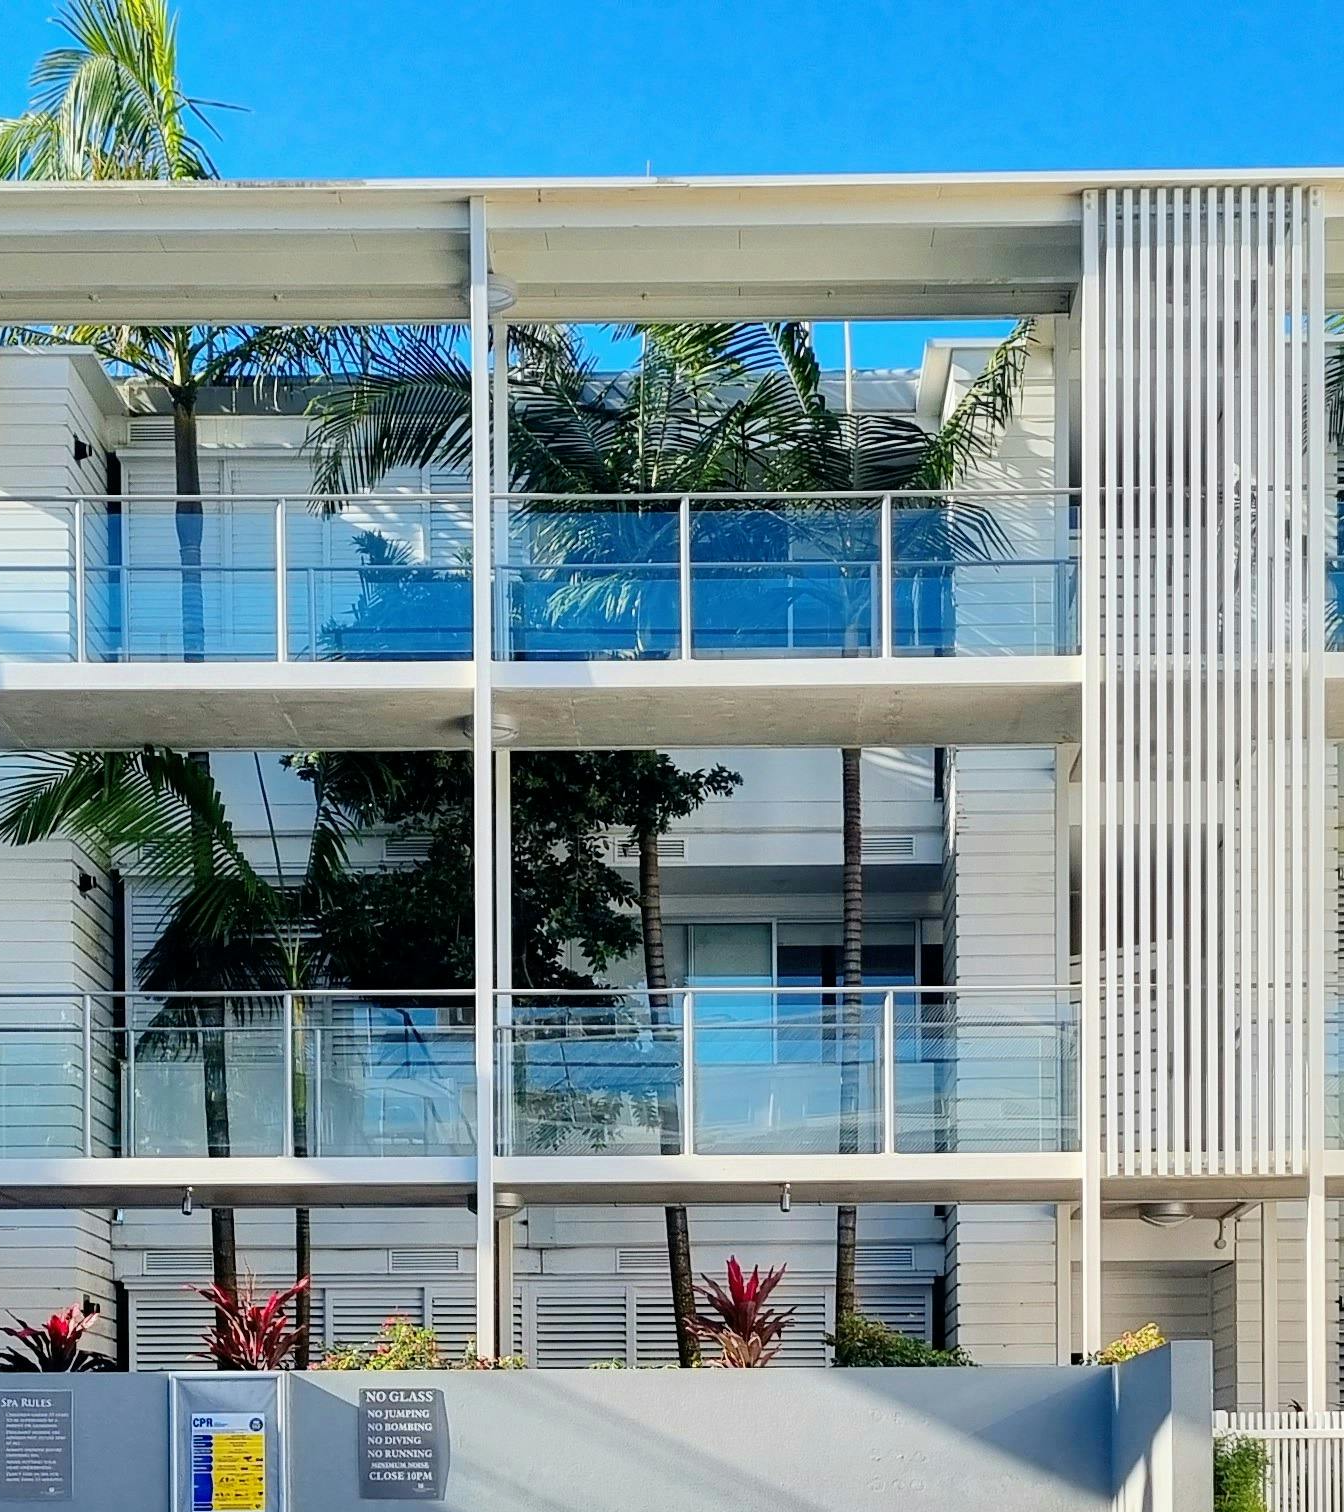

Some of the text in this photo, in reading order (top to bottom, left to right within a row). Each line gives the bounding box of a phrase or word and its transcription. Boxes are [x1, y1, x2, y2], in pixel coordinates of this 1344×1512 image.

[366, 1391, 433, 1402] NO GLASS
[368, 1410, 430, 1419] NO JUMPING
[193, 1418, 213, 1427] CPR
[368, 1423, 432, 1431] NO BOMBING
[368, 1436, 422, 1445] NO DIVING
[368, 1450, 432, 1458] NO RUNNING
[369, 1472, 432, 1480] CLOSE 10PM
